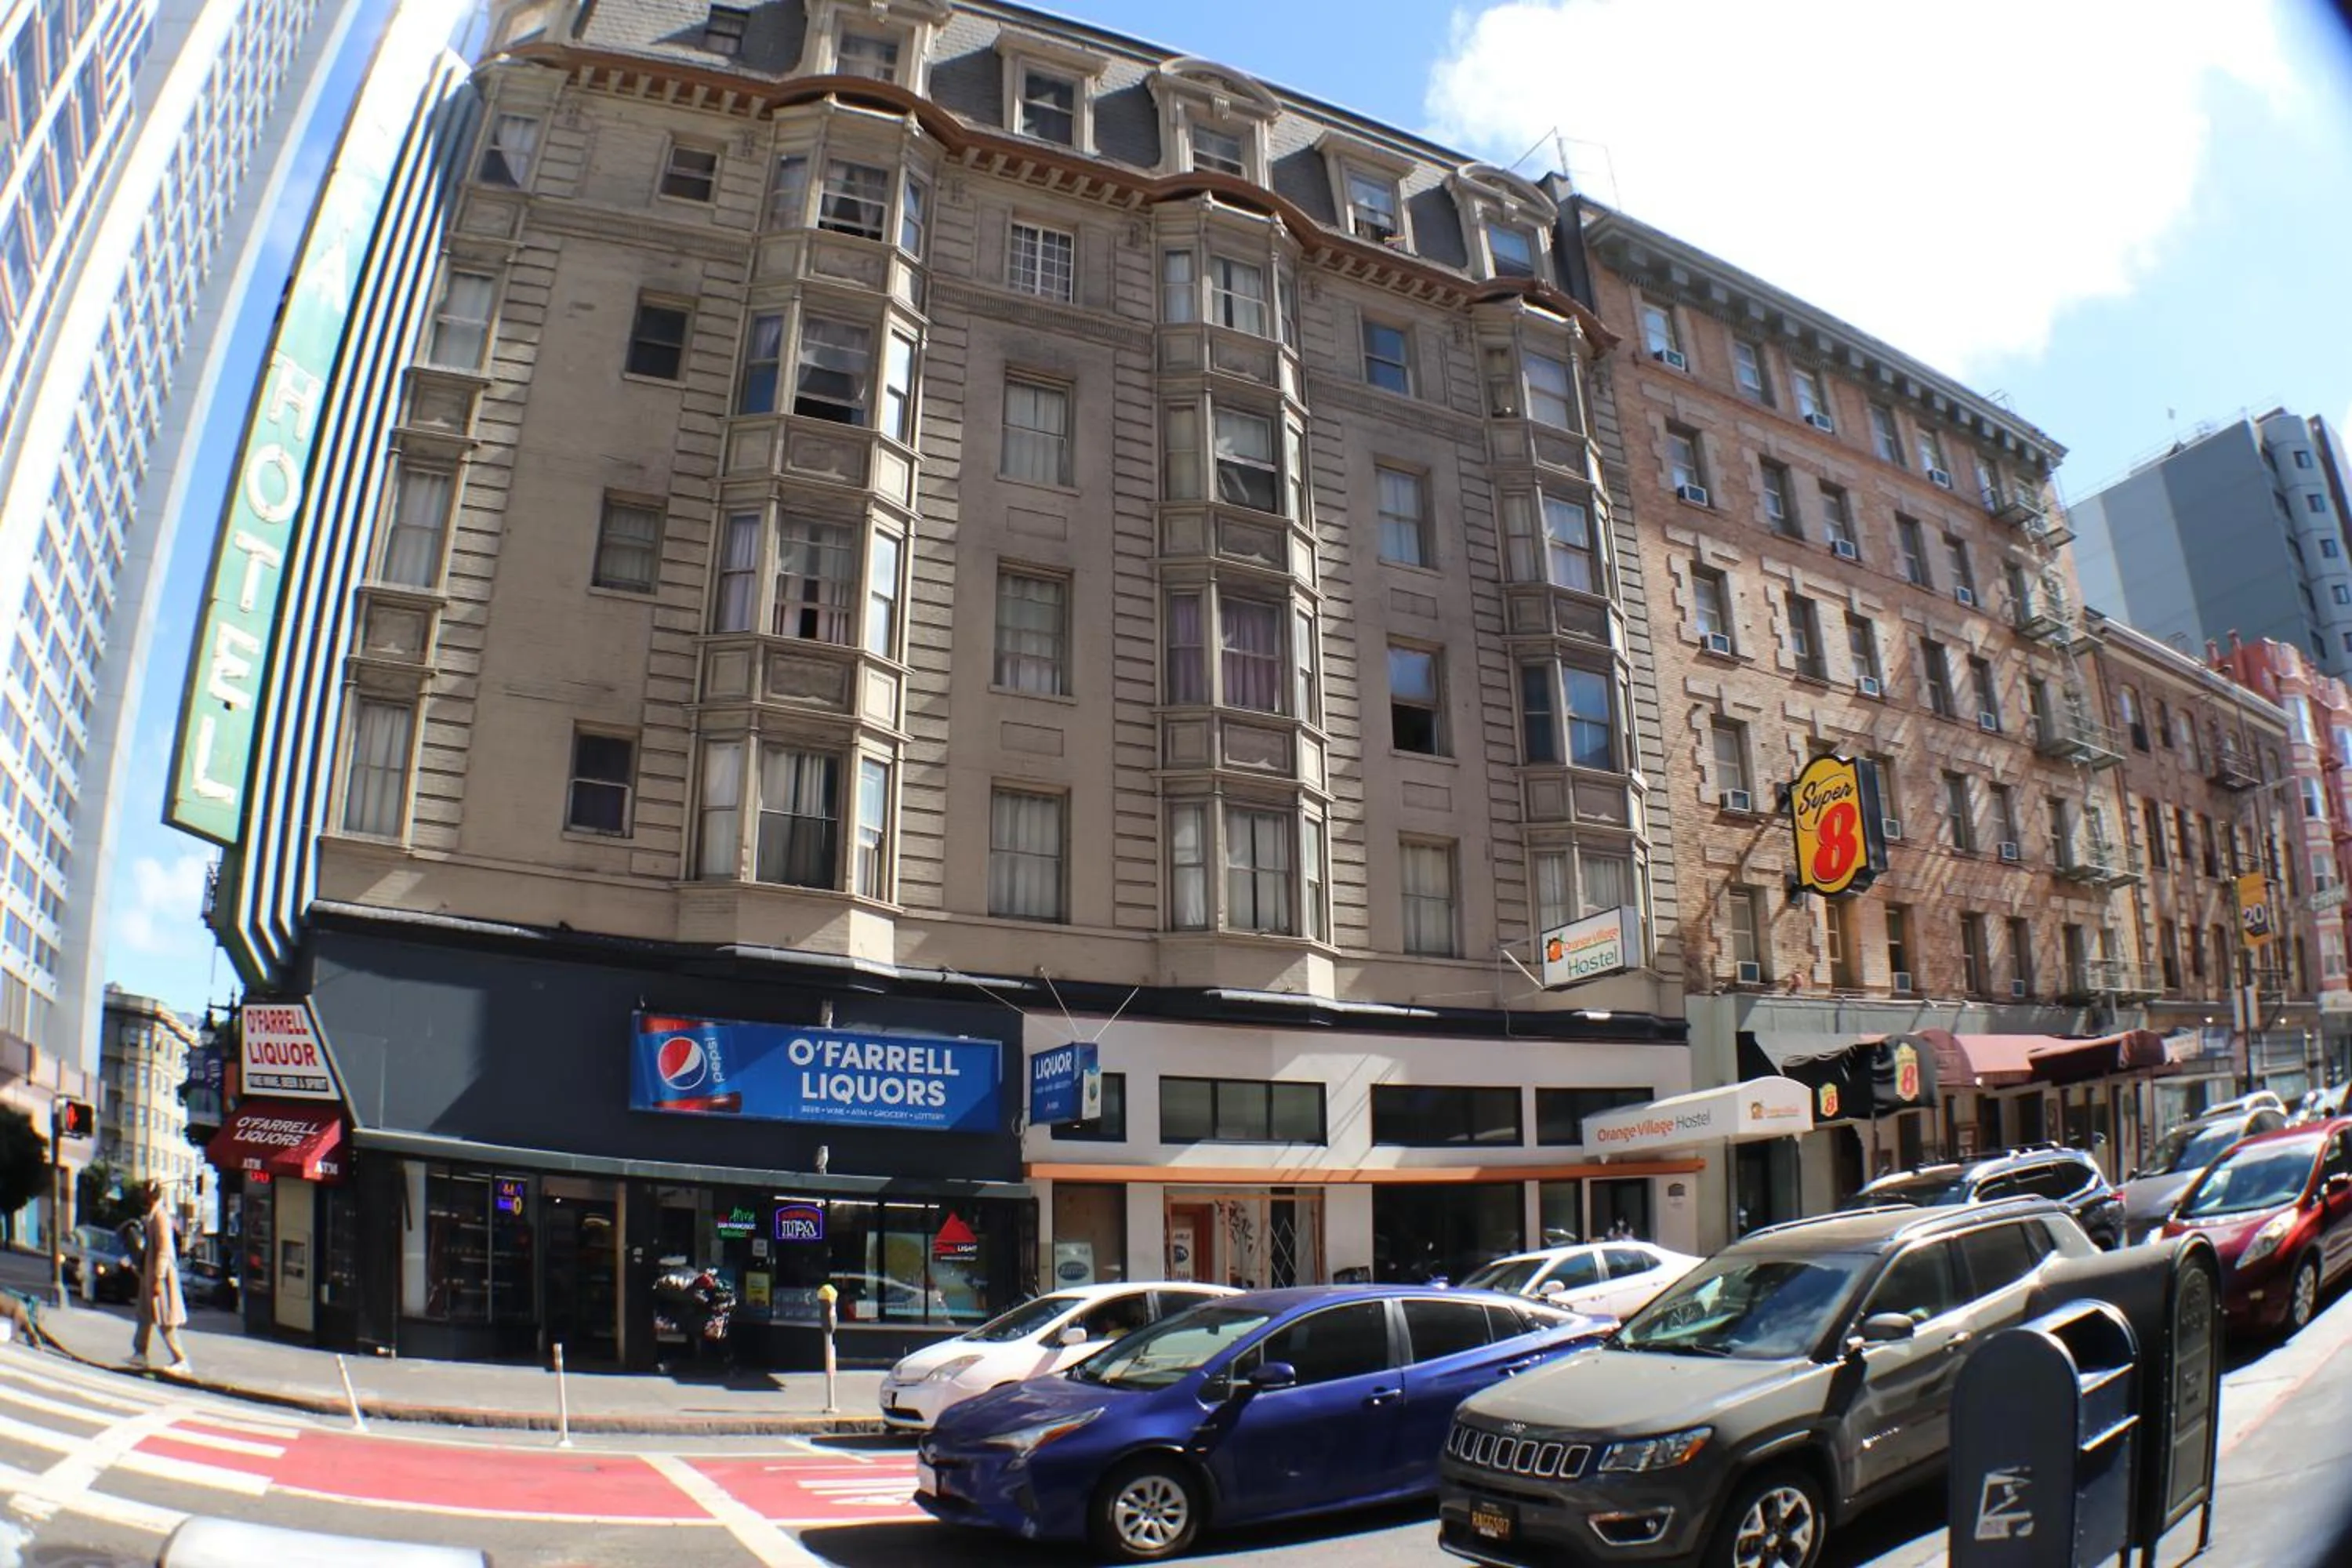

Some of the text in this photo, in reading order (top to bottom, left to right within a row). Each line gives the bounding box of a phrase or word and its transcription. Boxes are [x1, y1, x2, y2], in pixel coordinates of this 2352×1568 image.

[193, 354, 320, 804] HOTEL
[1798, 781, 1853, 825] Super
[1812, 802, 1857, 884] 8
[2242, 902, 2266, 927] 20
[1567, 945, 1618, 977] Hostel
[246, 1009, 309, 1035] O'FARRELL
[247, 1041, 318, 1066] LIQUOR
[704, 1037, 725, 1083] pepsi
[788, 1039, 960, 1076] O'FARRELL
[1035, 1051, 1073, 1080] LIQUOR
[802, 1072, 946, 1107] LIQUORS
[1902, 1065, 1915, 1094] 8
[1824, 1095, 1835, 1113] 8
[233, 1129, 304, 1146] LIQUORS
[236, 1116, 318, 1134] O'FARRELL
[1597, 1109, 1711, 1142] Orange Village Hostel
[314, 1160, 339, 1174] ATM
